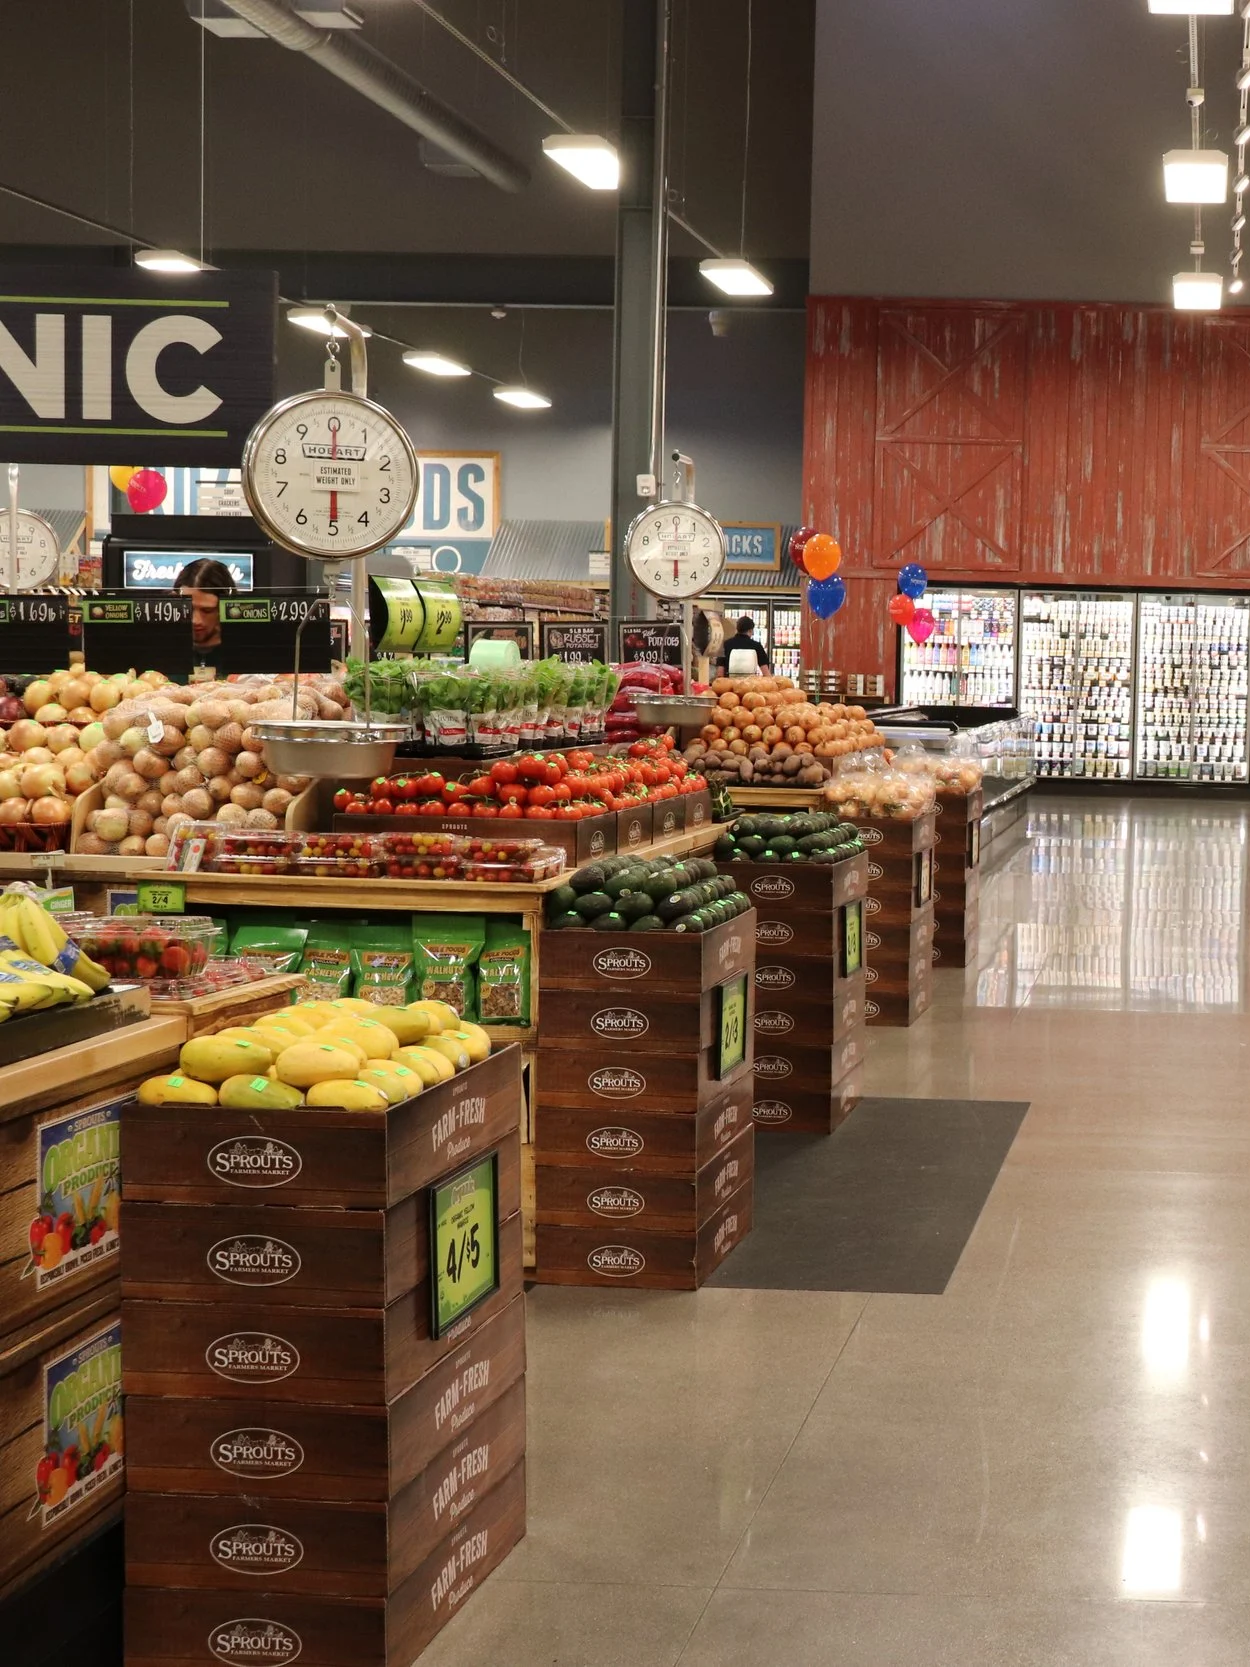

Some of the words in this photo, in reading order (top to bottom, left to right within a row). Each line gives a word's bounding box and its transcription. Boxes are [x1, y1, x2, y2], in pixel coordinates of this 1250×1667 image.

[328, 416, 340, 433] 0
[296, 423, 308, 441] 9
[361, 428, 367, 444] 1
[275, 448, 287, 465] 8
[379, 455, 391, 471] 2
[320, 466, 352, 476] ESTIMATED
[316, 476, 339, 485] WEIGHT
[340, 476, 356, 486] ONLY
[276, 481, 288, 498] 7
[379, 487, 391, 504] 3
[404, 463, 485, 531] DS
[296, 508, 308, 525] 6
[357, 511, 369, 527] 4
[672, 516, 681, 526] 0
[328, 520, 339, 536] 5
[654, 521, 662, 532] 9
[692, 522, 696, 532] 1
[40, 539, 47, 548] 8
[642, 536, 650, 546] 8
[702, 537, 710, 548] 2
[724, 534, 763, 557] ACKS
[702, 557, 710, 567] 3
[30, 567, 37, 576] 6
[654, 571, 662, 581] 6
[690, 571, 697, 581] 4
[672, 577, 679, 587] 5
[105, 604, 128, 612] YELLOW
[243, 608, 268, 618] ONIONS
[754, 883, 791, 893] SPROUTS
[50, 900, 72, 909] GINGER
[755, 928, 790, 938] SPROUTS
[426, 965, 464, 975] WALNUTS
[598, 957, 646, 970] SPROUTS
[755, 973, 792, 983] SPROUTS
[596, 1017, 644, 1030] SPROUTS
[754, 1018, 790, 1028] SPROUTS
[753, 1062, 789, 1073] SPROUTS
[592, 1077, 641, 1090] SPROUTS
[752, 1107, 788, 1117] SPROUTS
[431, 1097, 486, 1152] FARM-FRESH
[446, 1136, 471, 1161] Produce
[591, 1137, 639, 1149] SPROUTS
[215, 1152, 293, 1172] SPROUTS
[592, 1196, 639, 1209] SPROUTS
[446, 1223, 480, 1284] 4/$5
[215, 1250, 293, 1271] SPROUTS
[592, 1255, 640, 1268] SPROUTS
[214, 1348, 291, 1368] SPROUTS
[434, 1359, 490, 1431] FARM-FRESH
[451, 1402, 476, 1433] Produce
[218, 1443, 296, 1463] SPROUTS
[432, 1444, 489, 1521] FARM-FRESH
[450, 1488, 475, 1522] Produce
[218, 1540, 295, 1560] SPROUTS
[431, 1529, 488, 1612] FARM-FRESH
[449, 1575, 473, 1611] Produce
[216, 1634, 293, 1653] SPROUTS
